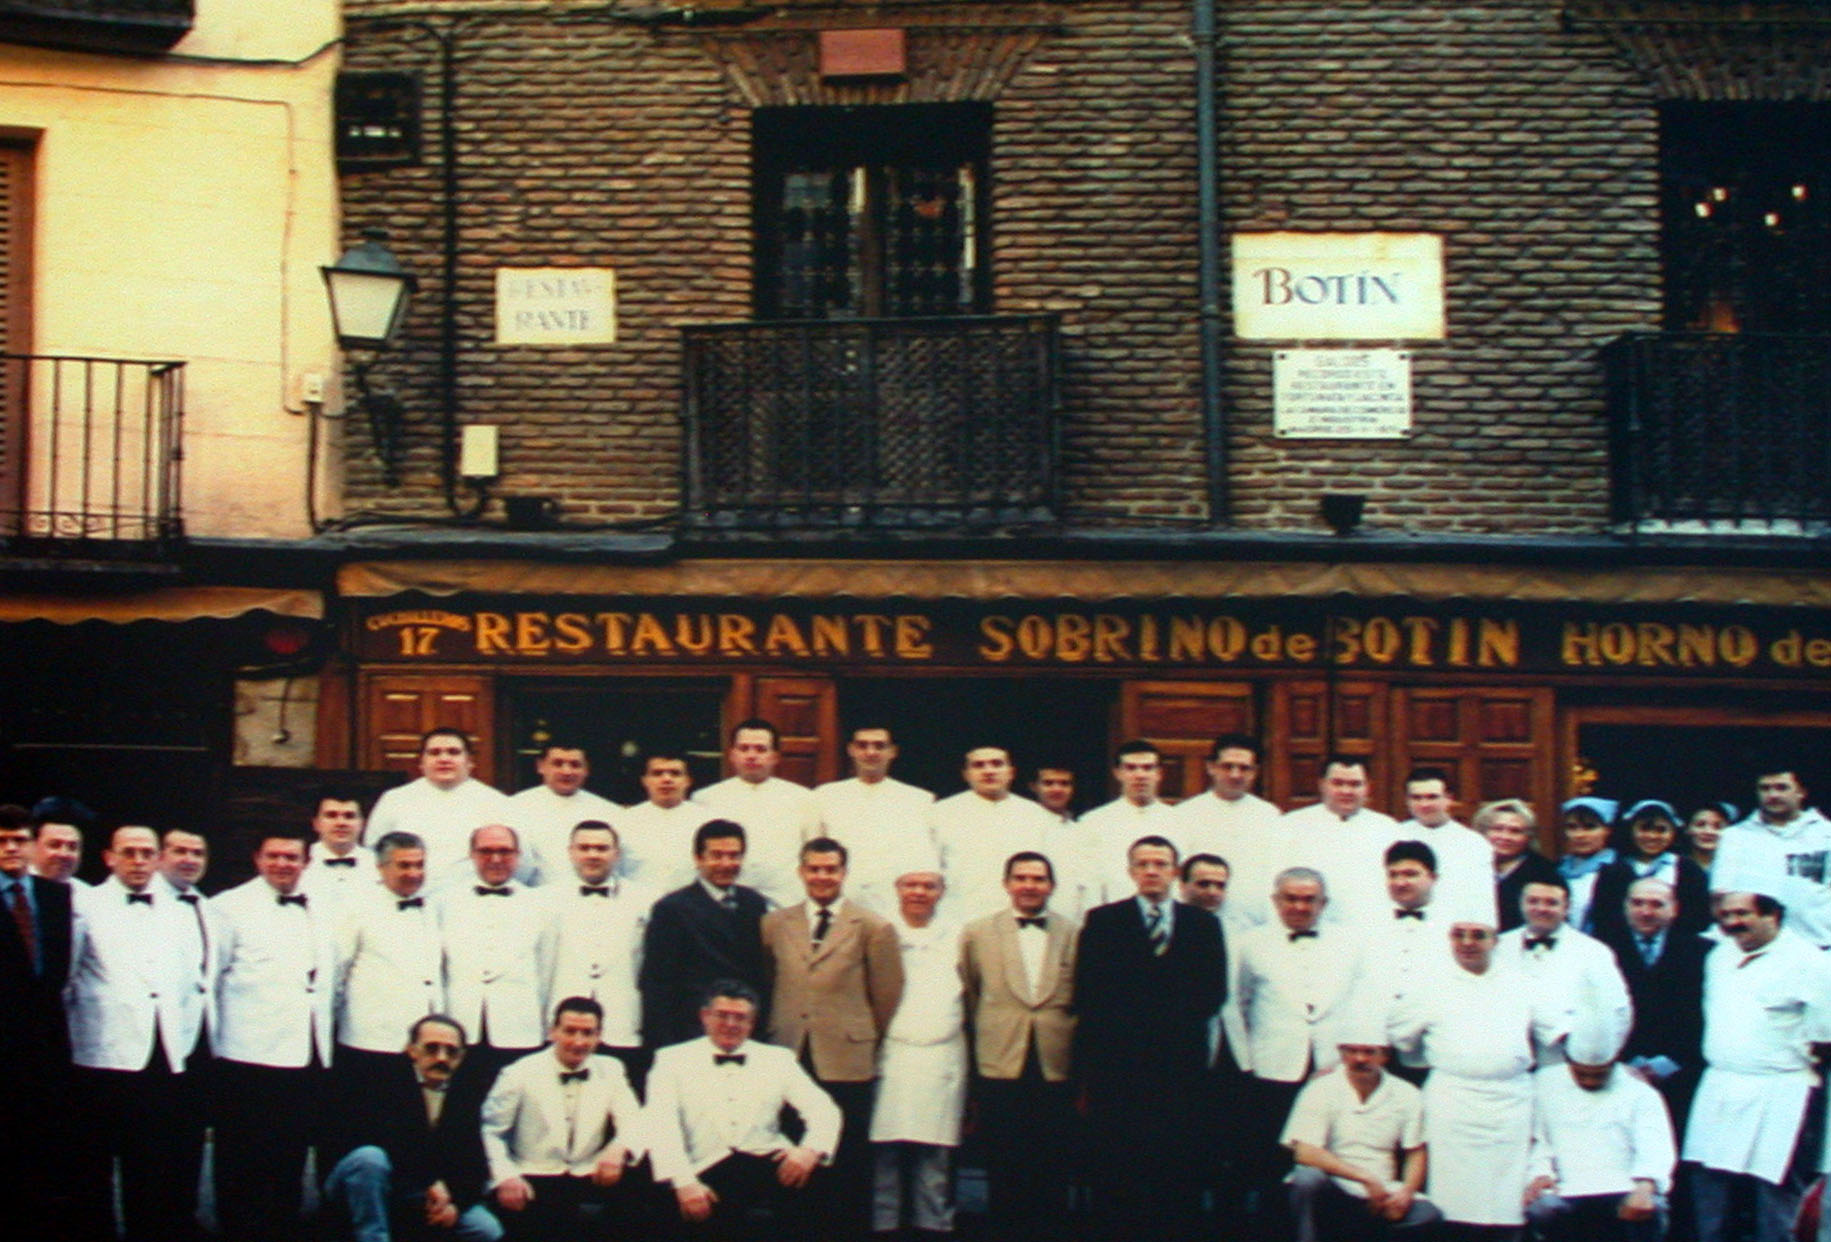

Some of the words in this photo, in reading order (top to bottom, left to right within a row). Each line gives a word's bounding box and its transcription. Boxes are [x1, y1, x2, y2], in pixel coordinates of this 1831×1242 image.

[399, 626, 440, 656] 17
[474, 611, 934, 659] RESTAURANTE
[978, 613, 1249, 662] SOBRINO
[1249, 624, 1317, 662] de
[1332, 616, 1521, 668] BOTIN
[1560, 620, 1760, 668] HORNO
[1769, 628, 1831, 668] de
